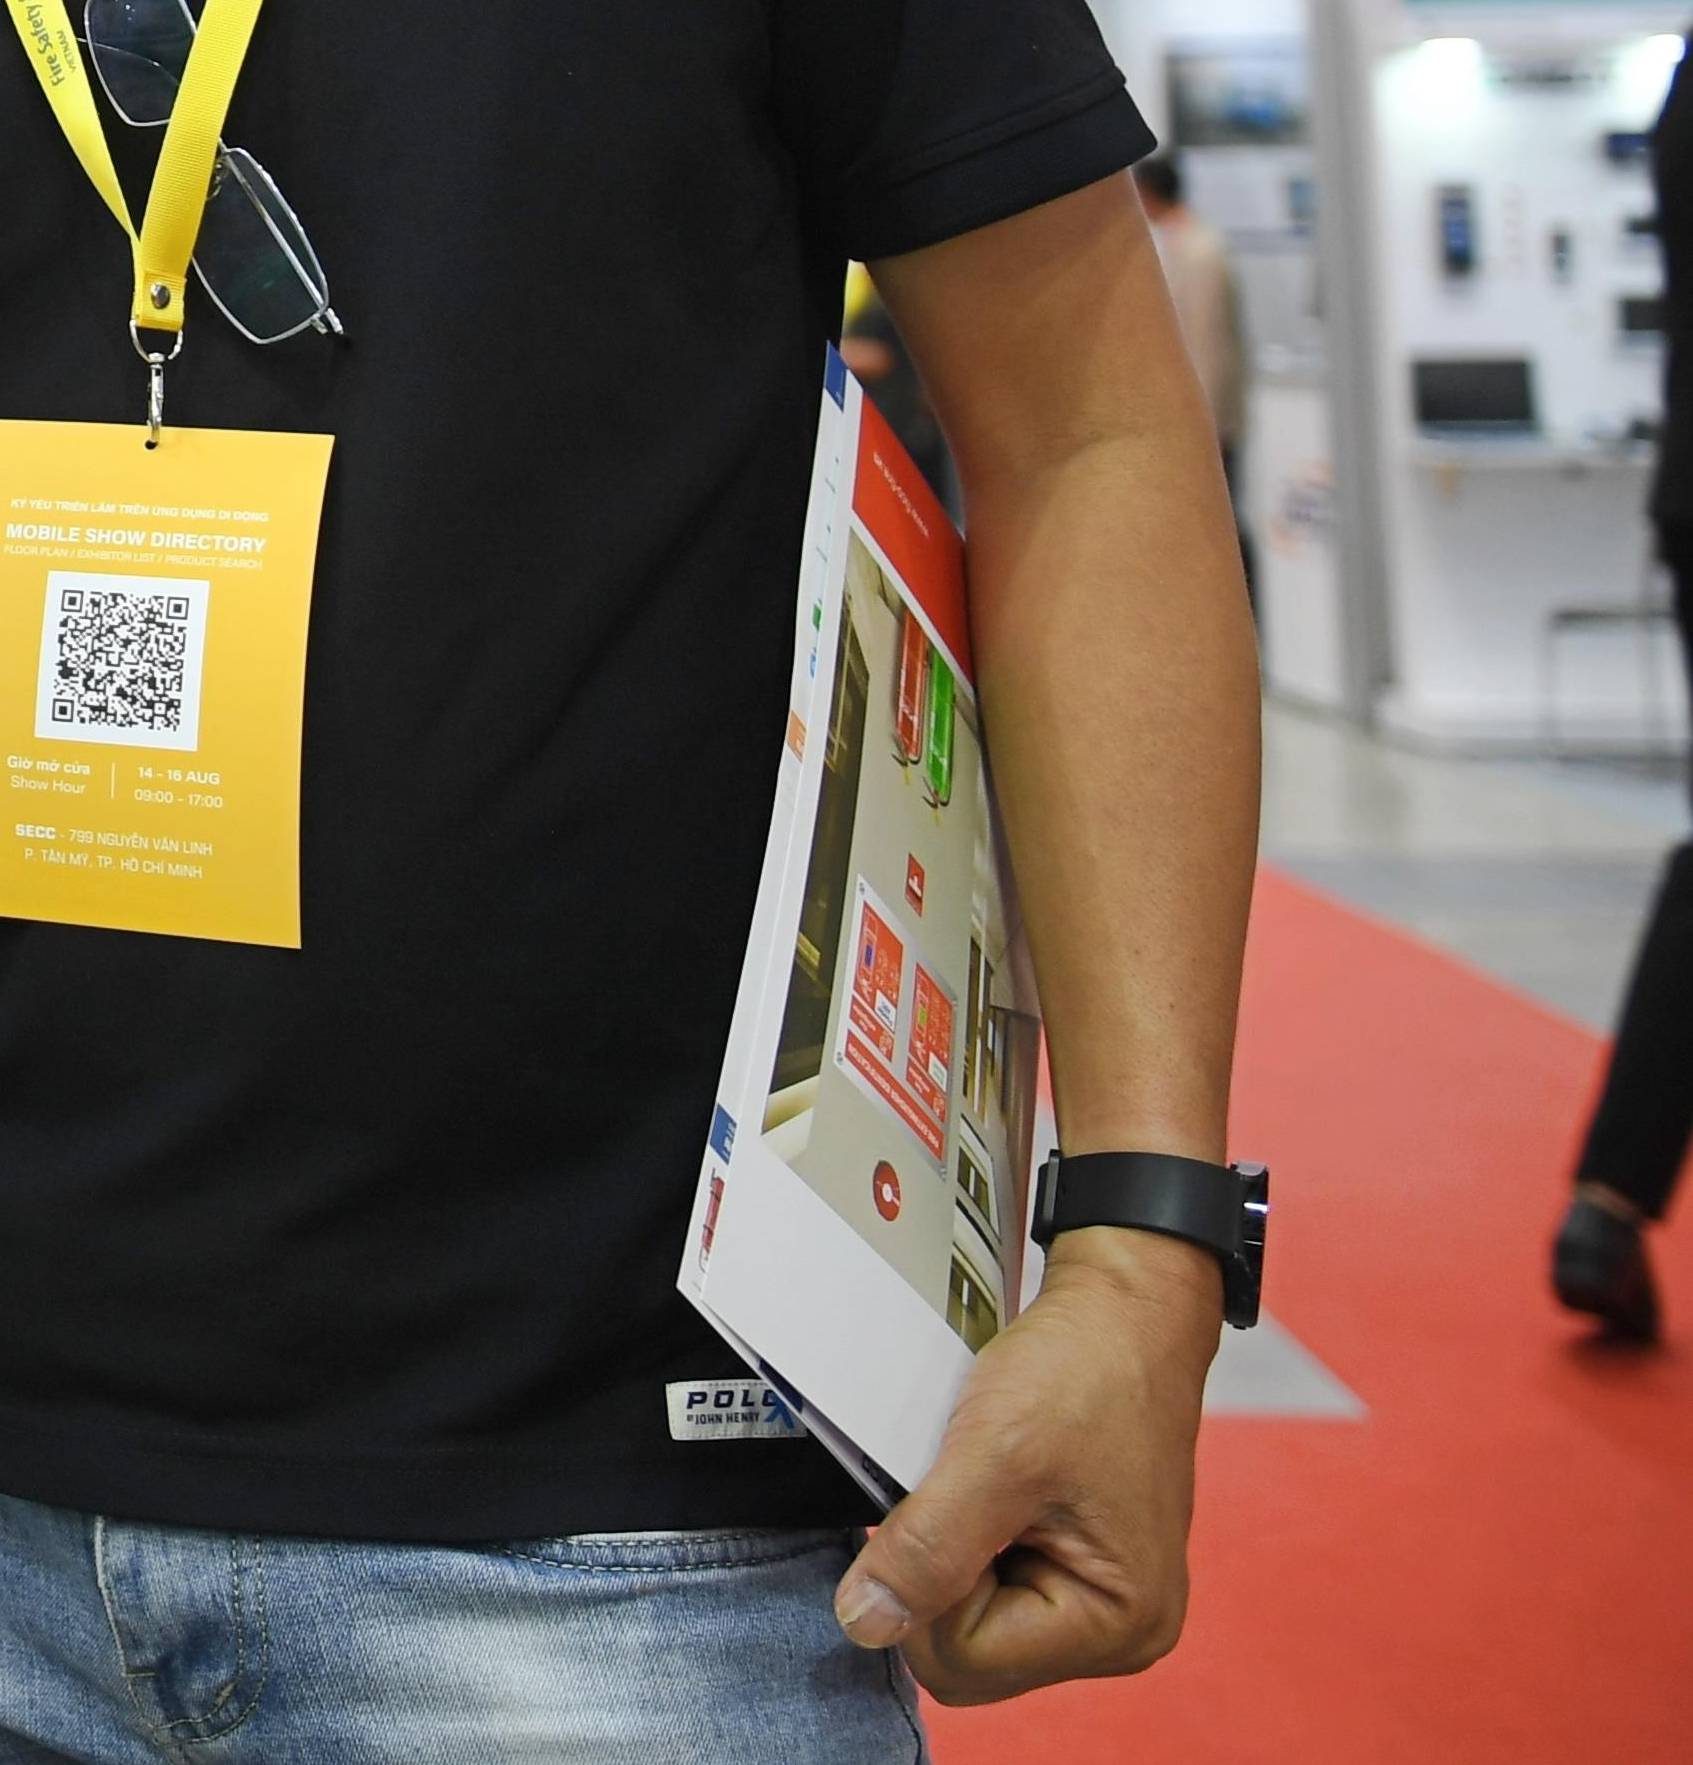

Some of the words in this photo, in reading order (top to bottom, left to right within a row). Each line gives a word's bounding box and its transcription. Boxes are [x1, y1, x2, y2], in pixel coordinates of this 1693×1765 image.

[26, 3, 53, 54] Safety
[56, 30, 76, 73] VIETNAM
[47, 54, 66, 87] Fire
[6, 523, 81, 543] MOBILE
[85, 528, 146, 547] SHOW
[150, 532, 267, 554] DIRECTORY
[3, 544, 39, 557] FLOOR
[39, 546, 68, 558] PLAN
[77, 549, 132, 562] EXHIBITOR
[134, 552, 155, 564] LIST
[165, 554, 217, 567] PRODUCT
[219, 556, 263, 570] SEARCH
[7, 755, 31, 770] Giờ
[138, 766, 153, 779] 14
[167, 768, 182, 782] 16
[185, 770, 220, 785] AUG
[10, 775, 48, 791] Show
[52, 779, 86, 794] Hour
[134, 788, 173, 804] 09:00
[188, 793, 223, 808] 17:00
[15, 823, 56, 840] SECC
[182, 840, 213, 856] LINH
[40, 848, 66, 865] TÂN
[142, 859, 164, 874] CHÍ
[167, 862, 203, 879] MINH
[695, 1413, 723, 1426] JOHN
[726, 1411, 761, 1424] HENRY
